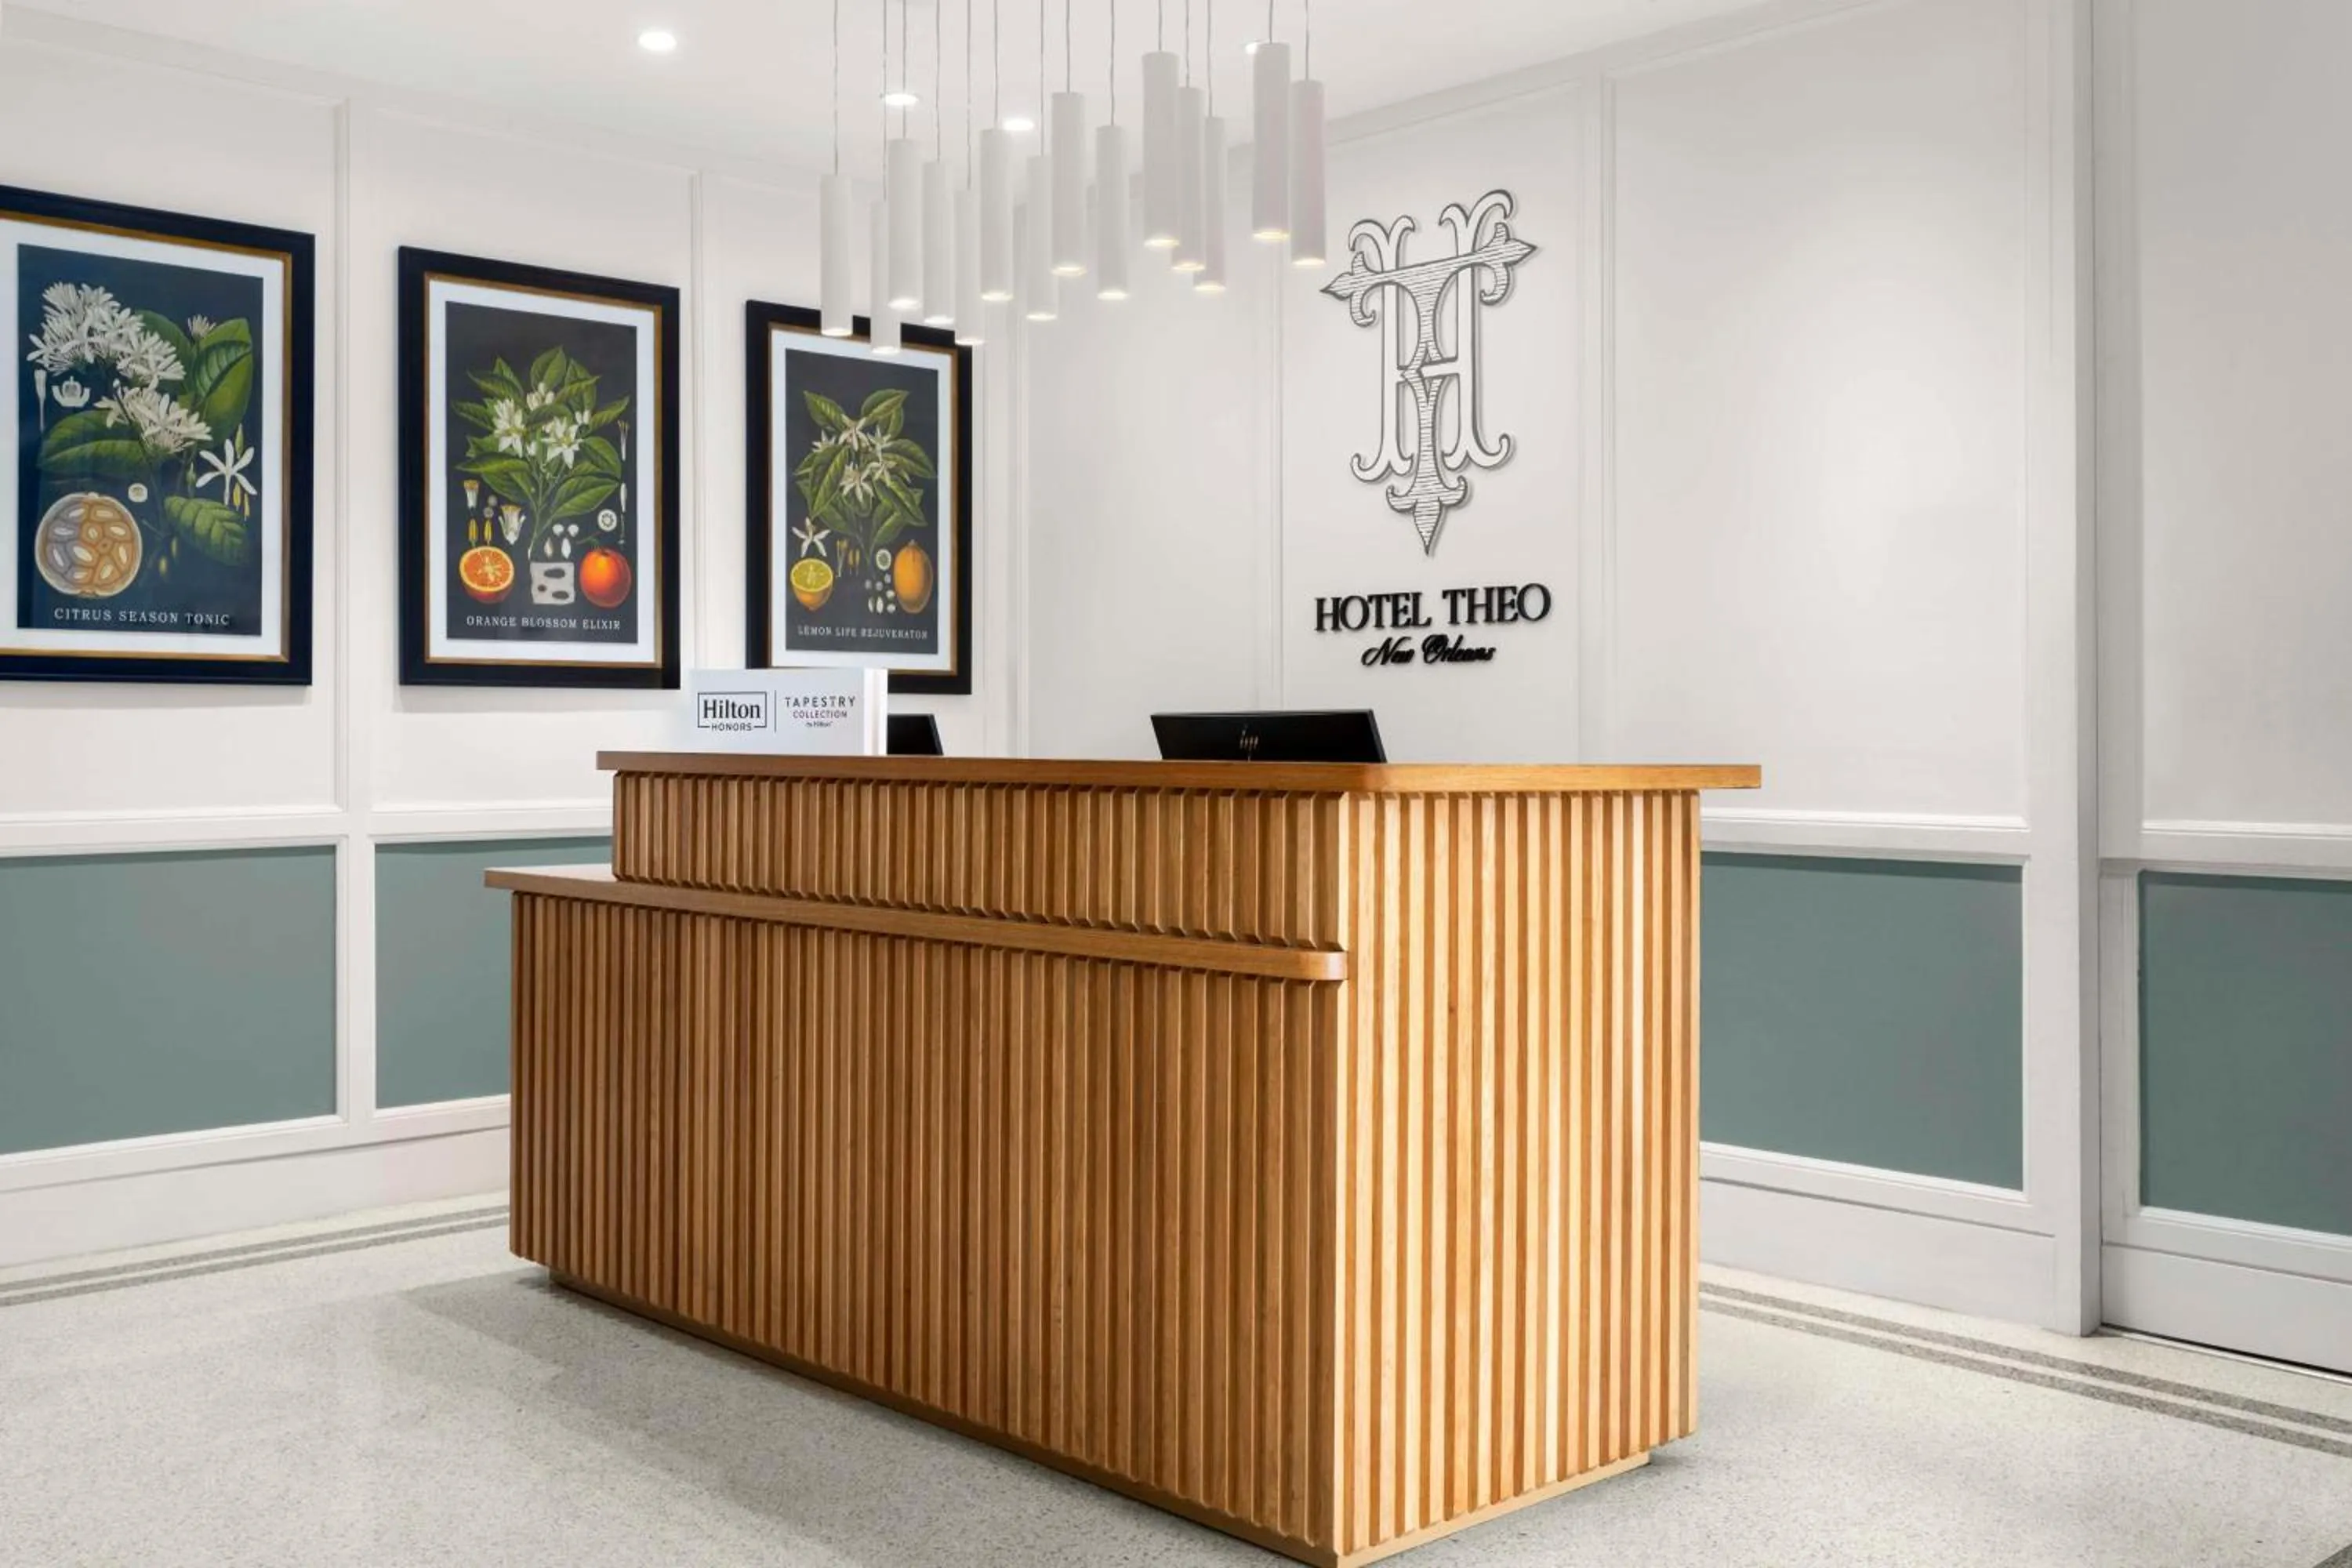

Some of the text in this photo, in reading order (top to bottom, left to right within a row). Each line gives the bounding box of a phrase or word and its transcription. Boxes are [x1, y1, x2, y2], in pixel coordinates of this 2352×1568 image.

[1314, 583, 1552, 632] HOTEL THEO
[53, 608, 230, 626] CITRUS SEASON TONIC
[466, 615, 621, 630] ORANGE BLOSSOM ELIXIR
[797, 625, 928, 640] LEMON LIFE REJUVENATOR
[1361, 633, 1496, 666] New Orleans
[785, 695, 855, 707] TAPESTRY
[702, 699, 761, 719] Hilton
[793, 710, 848, 719] COLLECTION
[711, 723, 753, 732] HONORS
